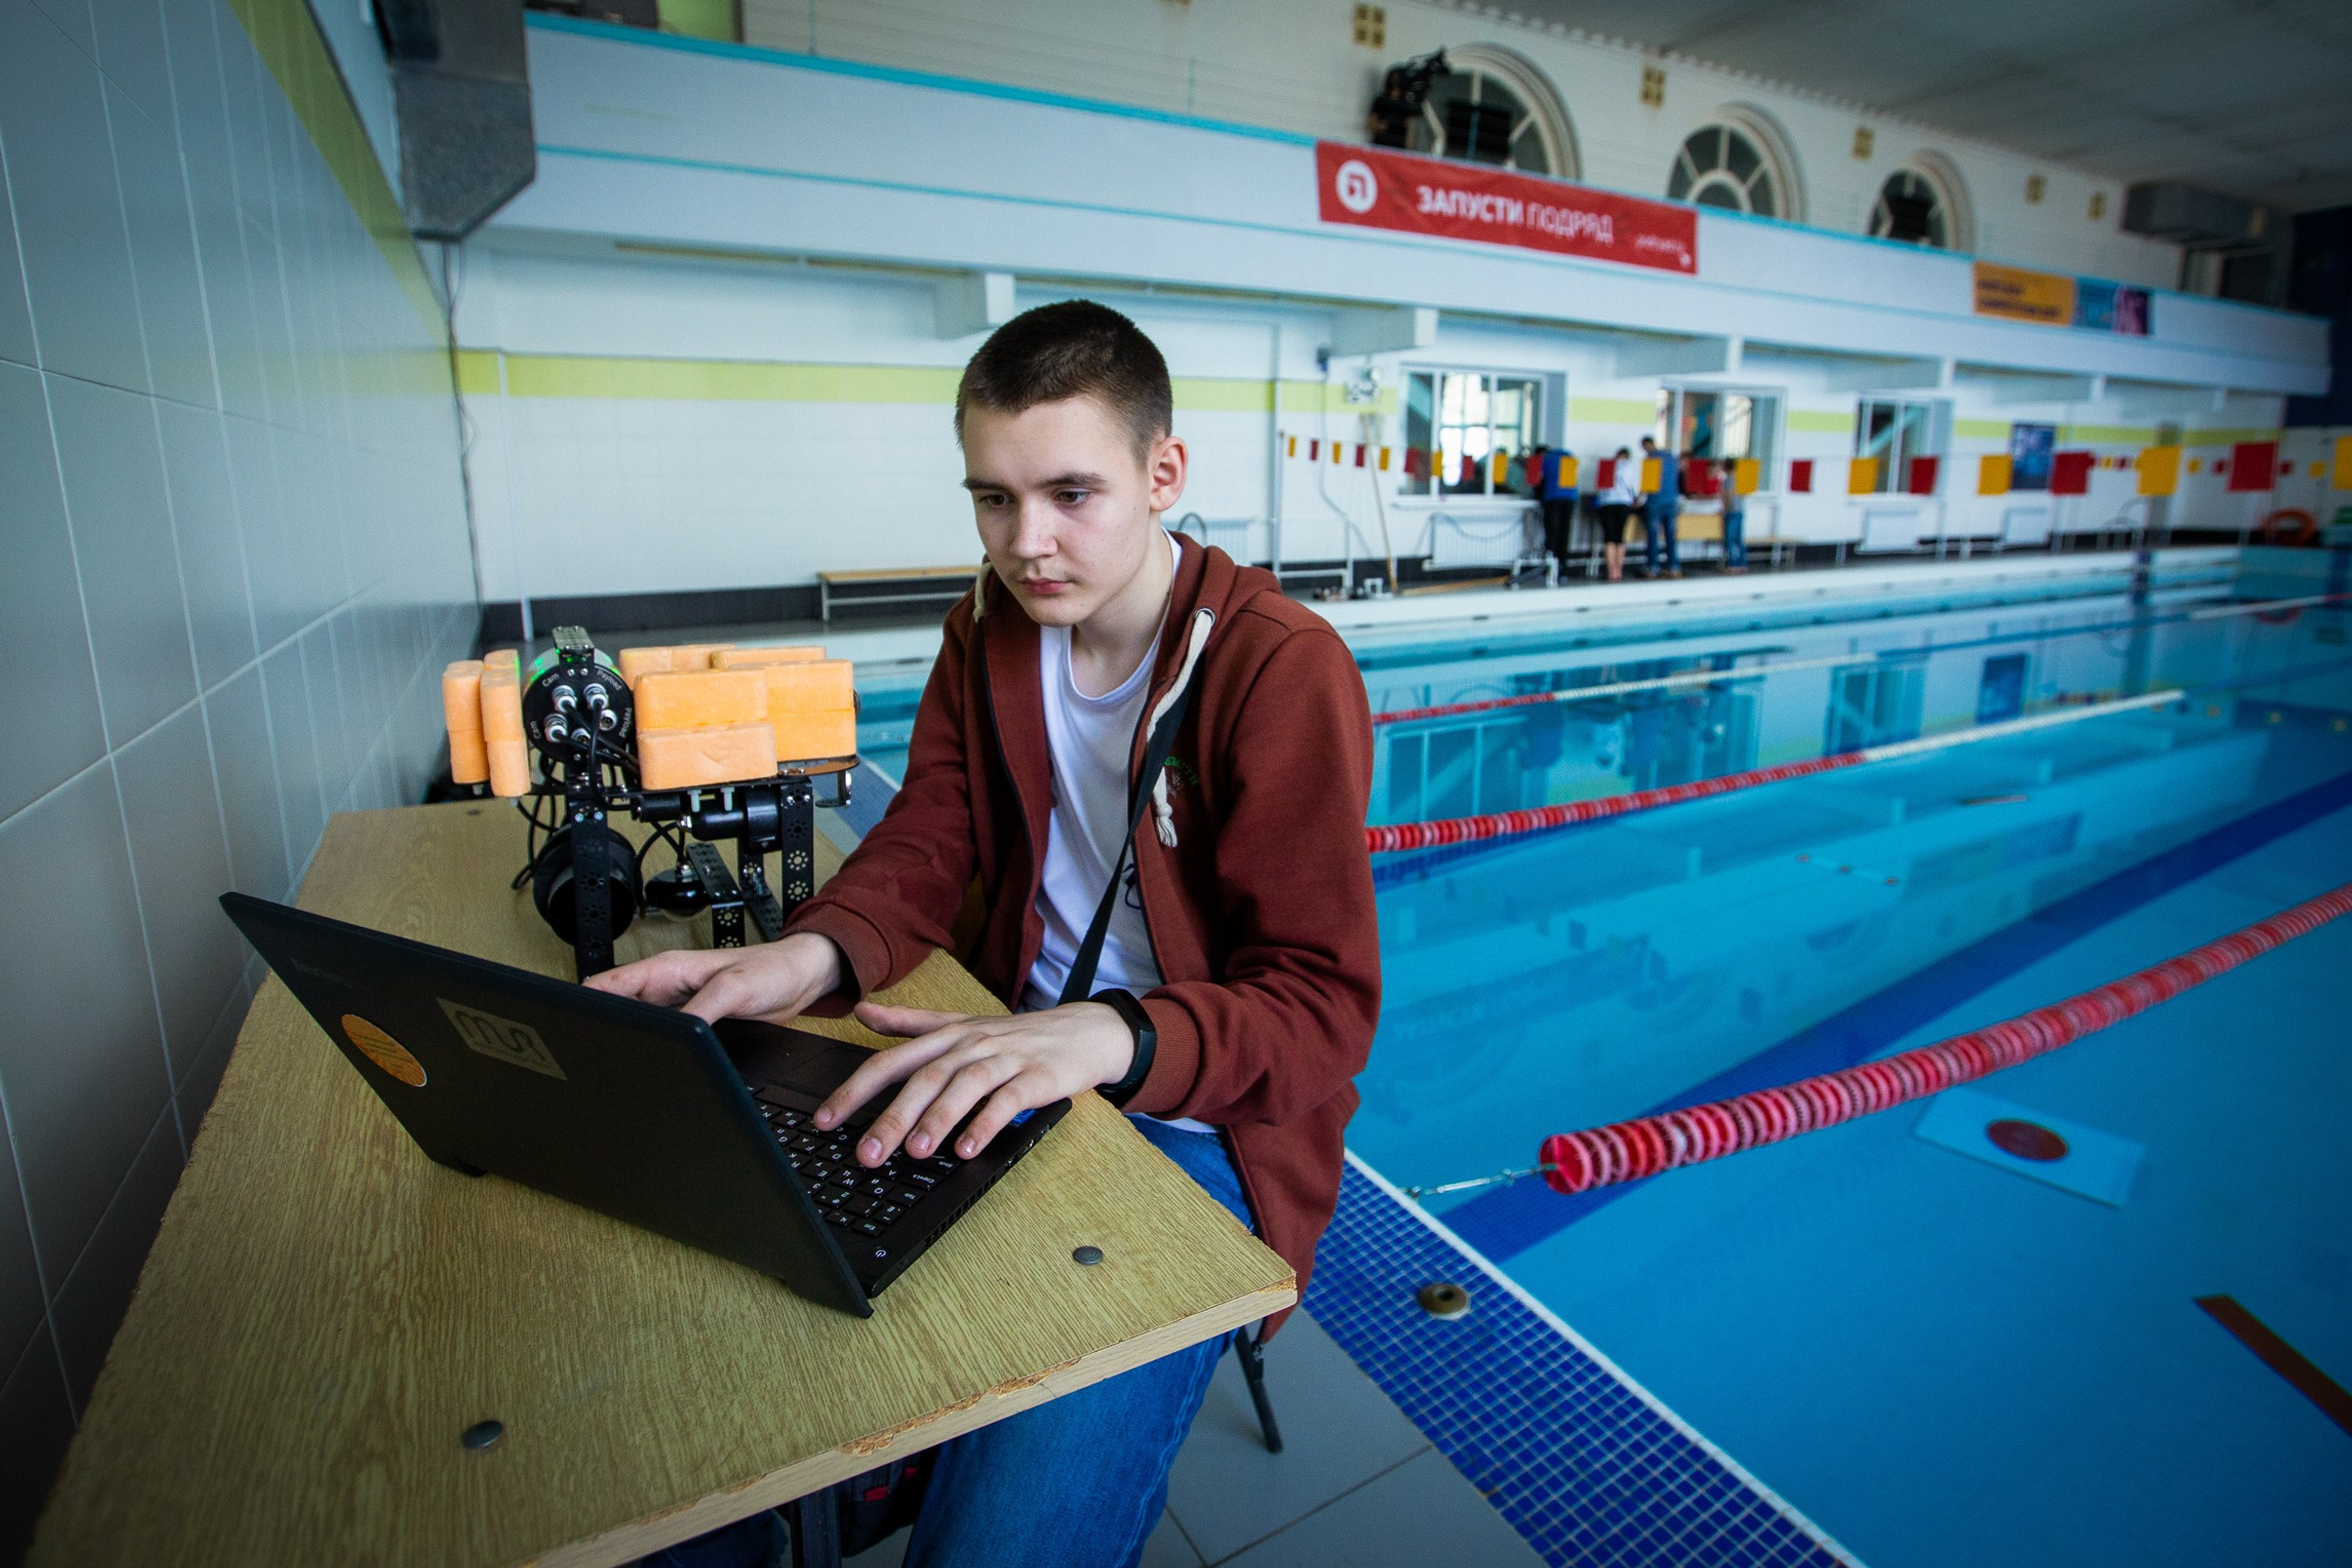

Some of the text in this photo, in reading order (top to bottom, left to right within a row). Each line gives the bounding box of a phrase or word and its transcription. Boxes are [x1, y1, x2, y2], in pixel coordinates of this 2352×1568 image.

[1416, 185, 1525, 226] ЗАПУСТИ
[542, 672, 560, 687] Cam
[596, 670, 623, 691] Payload
[530, 720, 541, 739] Cam
[618, 707, 632, 738] Payload
